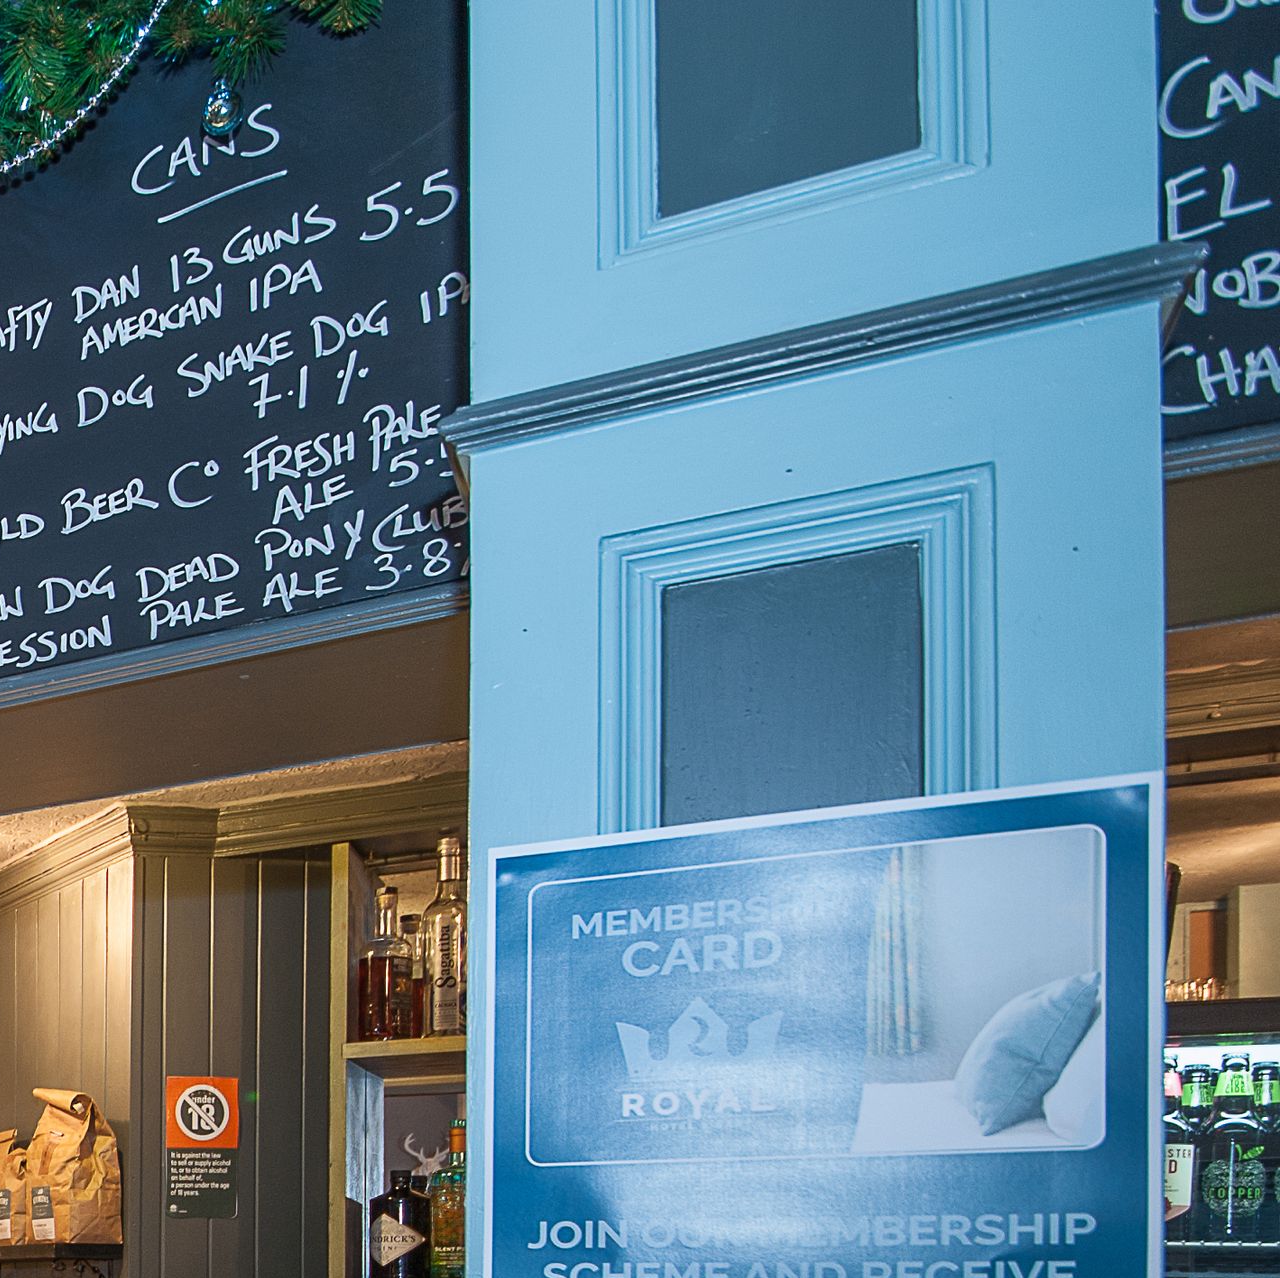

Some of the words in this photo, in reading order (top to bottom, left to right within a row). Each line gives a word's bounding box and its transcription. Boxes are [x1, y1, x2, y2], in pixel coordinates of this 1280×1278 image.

[132, 104, 280, 195] CANS
[1165, 163, 1272, 241] EL
[73, 265, 140, 324] DAN
[171, 247, 213, 293] 13
[222, 204, 337, 265] GUNS
[80, 284, 223, 360] AMERICAN
[249, 259, 323, 312] IPA
[78, 374, 154, 427] DOG
[177, 331, 293, 397] SNAKE
[311, 300, 388, 359] DOG
[61, 478, 158, 535] BEER
[243, 431, 355, 490] FRESH
[363, 403, 441, 470] PALE
[272, 475, 354, 525] ALE
[39, 565, 116, 612] DOG
[137, 553, 240, 603] DEAD
[255, 508, 365, 569] PONY
[141, 593, 245, 639] PALE
[262, 569, 343, 612] ALE
[571, 892, 840, 940] MEMBERS
[622, 930, 784, 978] CARD
[188, 1104, 215, 1130] 18
[621, 1088, 777, 1120] ROYAL
[528, 1219, 629, 1250] JOIN
